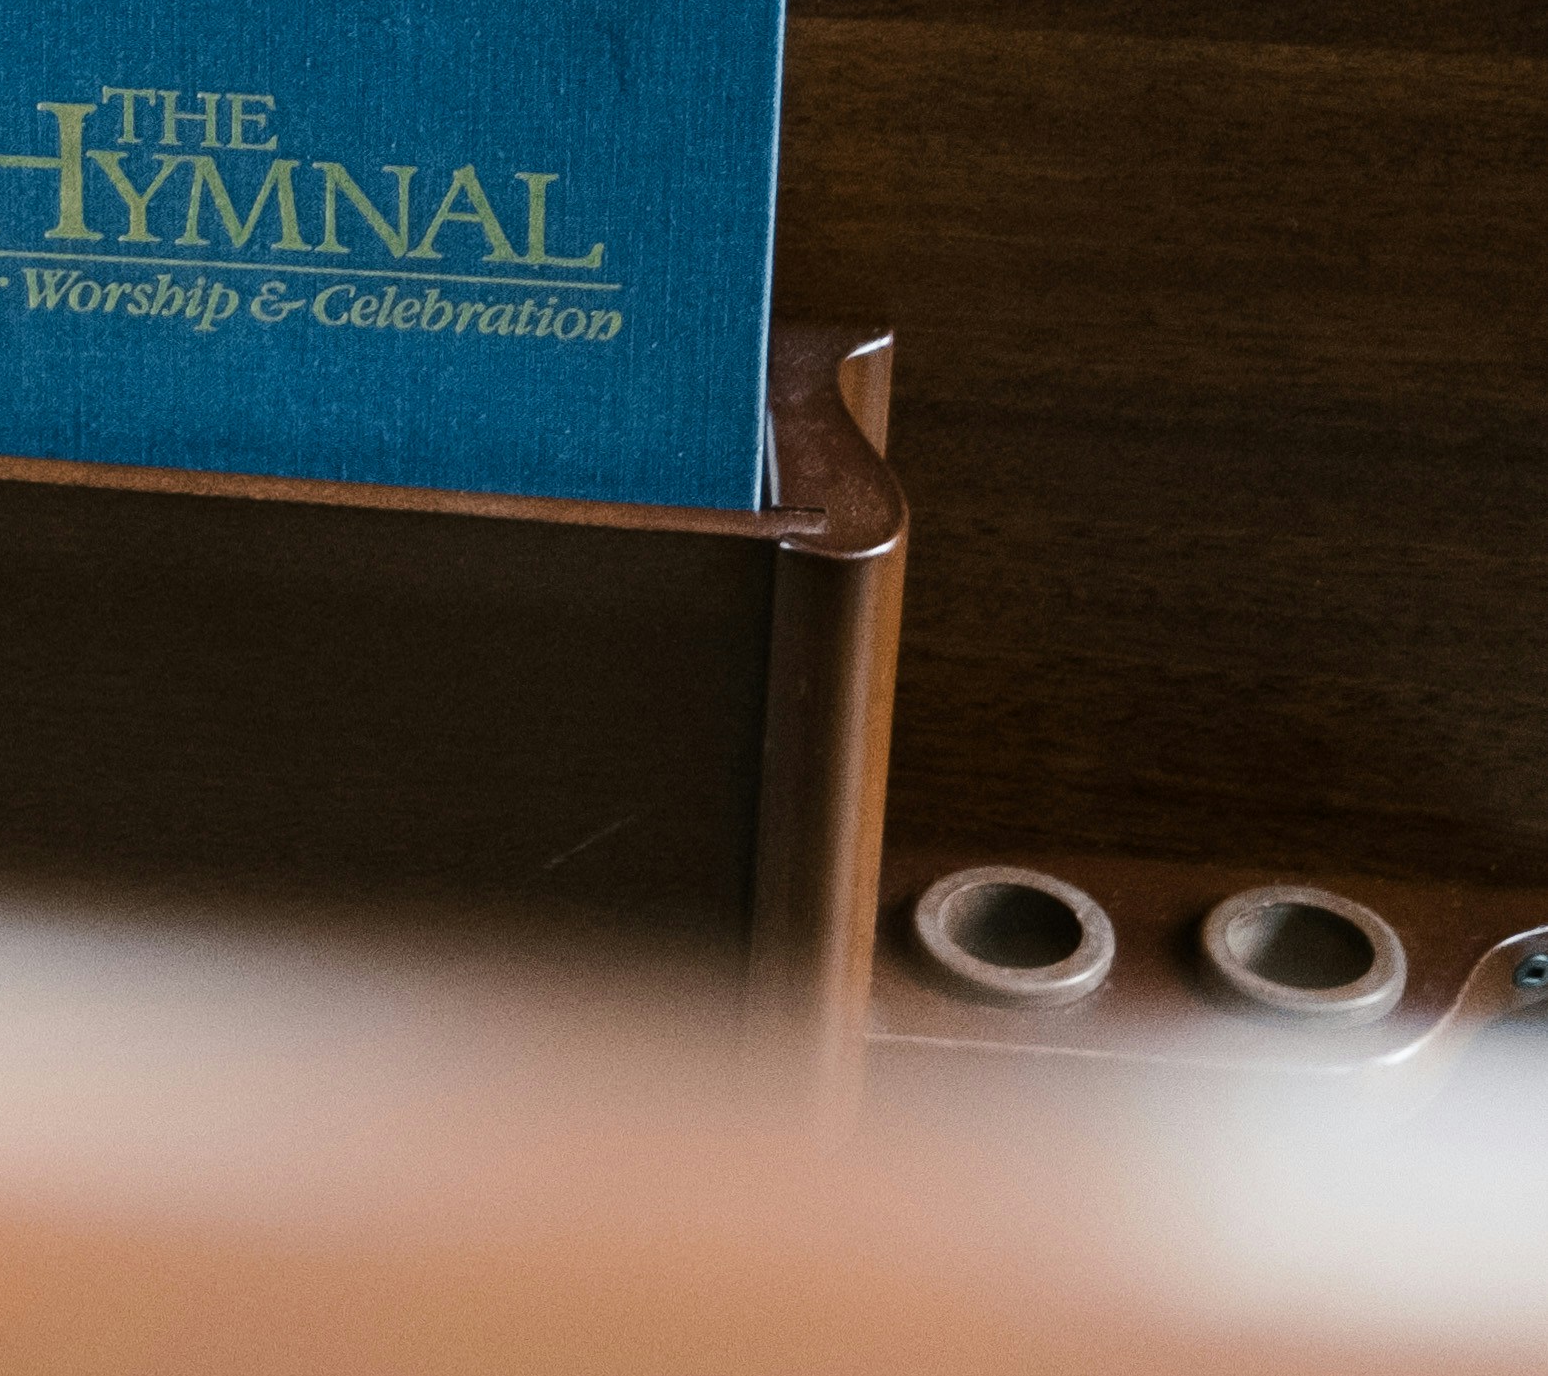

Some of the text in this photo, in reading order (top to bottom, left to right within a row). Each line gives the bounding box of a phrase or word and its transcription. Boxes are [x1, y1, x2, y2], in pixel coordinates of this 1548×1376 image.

[101, 85, 278, 151] THE
[22, 267, 239, 332] Worship
[250, 282, 305, 323] &
[312, 283, 622, 342] Celebration
